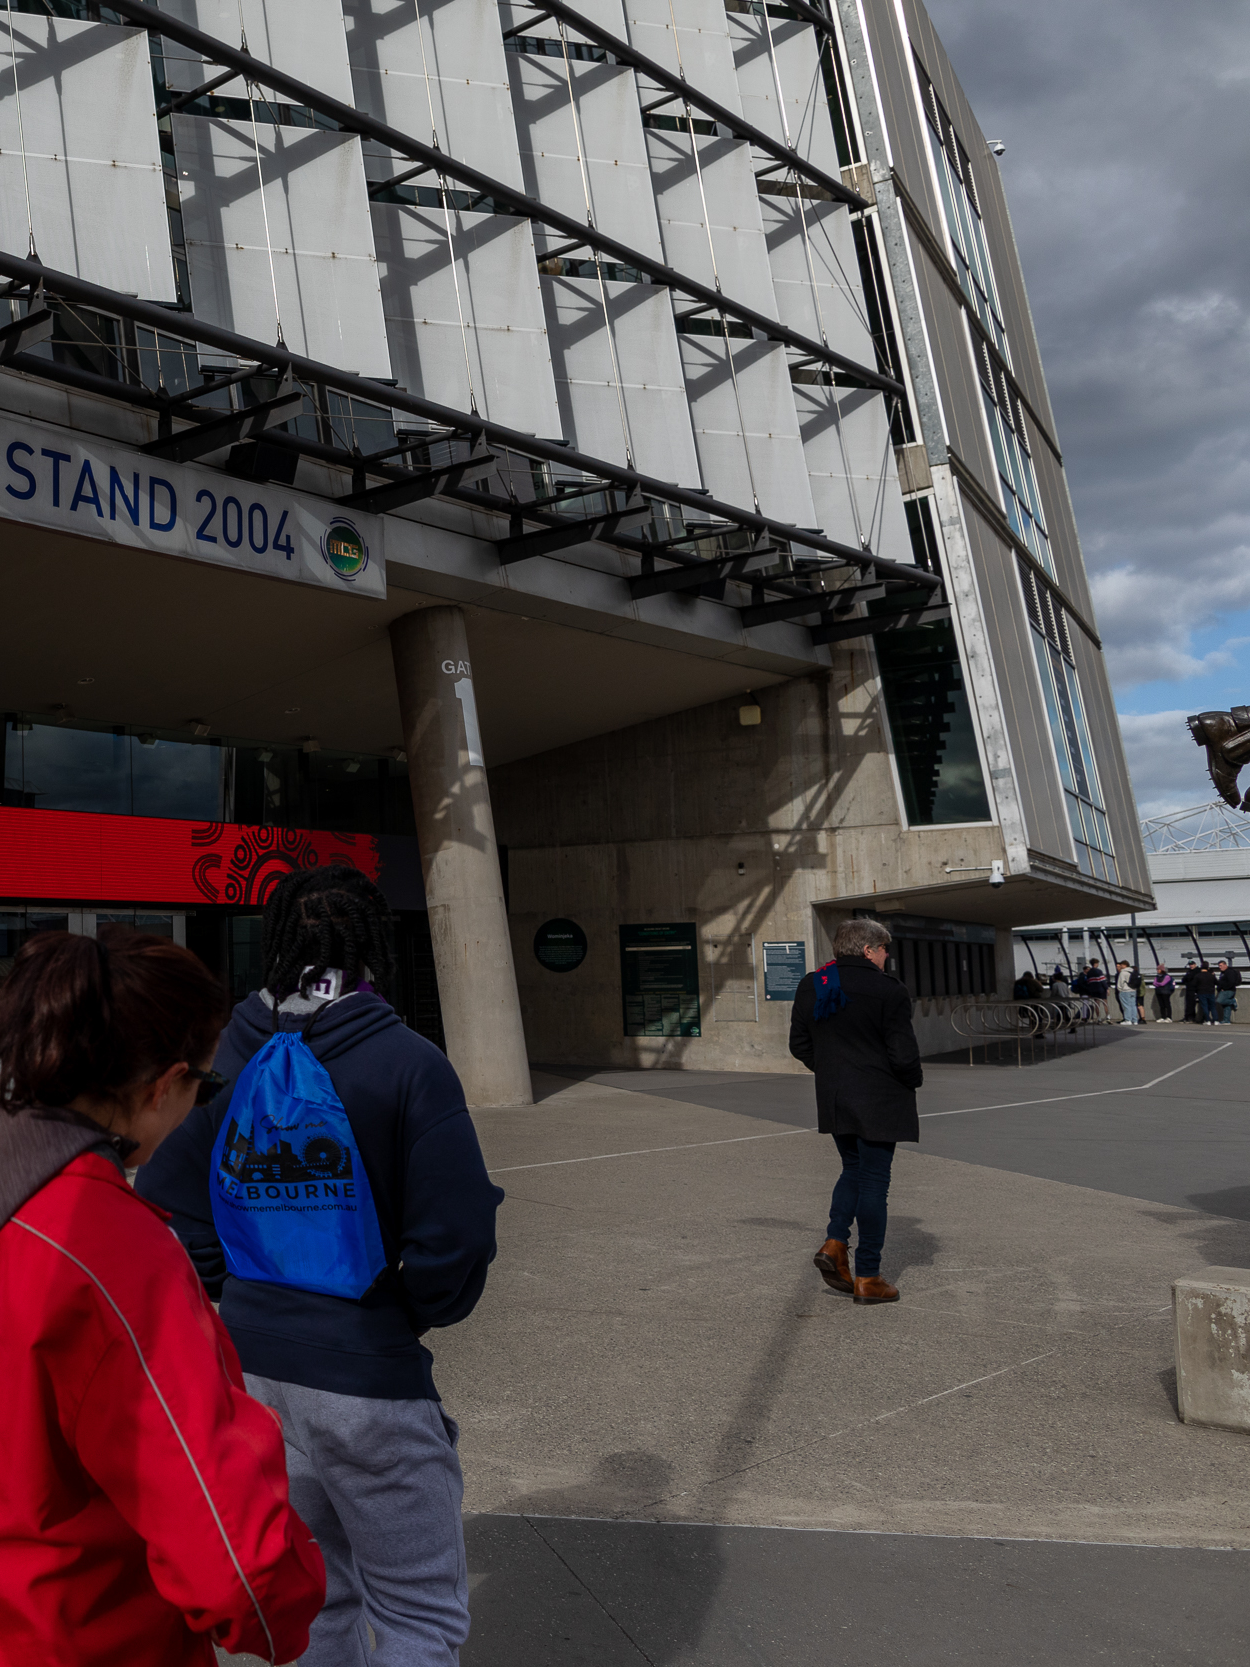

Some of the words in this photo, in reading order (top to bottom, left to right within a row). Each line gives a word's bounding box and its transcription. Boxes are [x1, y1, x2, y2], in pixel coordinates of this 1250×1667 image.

[5, 439, 178, 533] STAND
[195, 489, 296, 561] 2004
[329, 538, 359, 559] MCG
[441, 659, 471, 676] GAT
[454, 677, 484, 767] 1
[259, 1113, 300, 1135] Show
[305, 1120, 328, 1130] me
[216, 1172, 356, 1200] MELBOURNE
